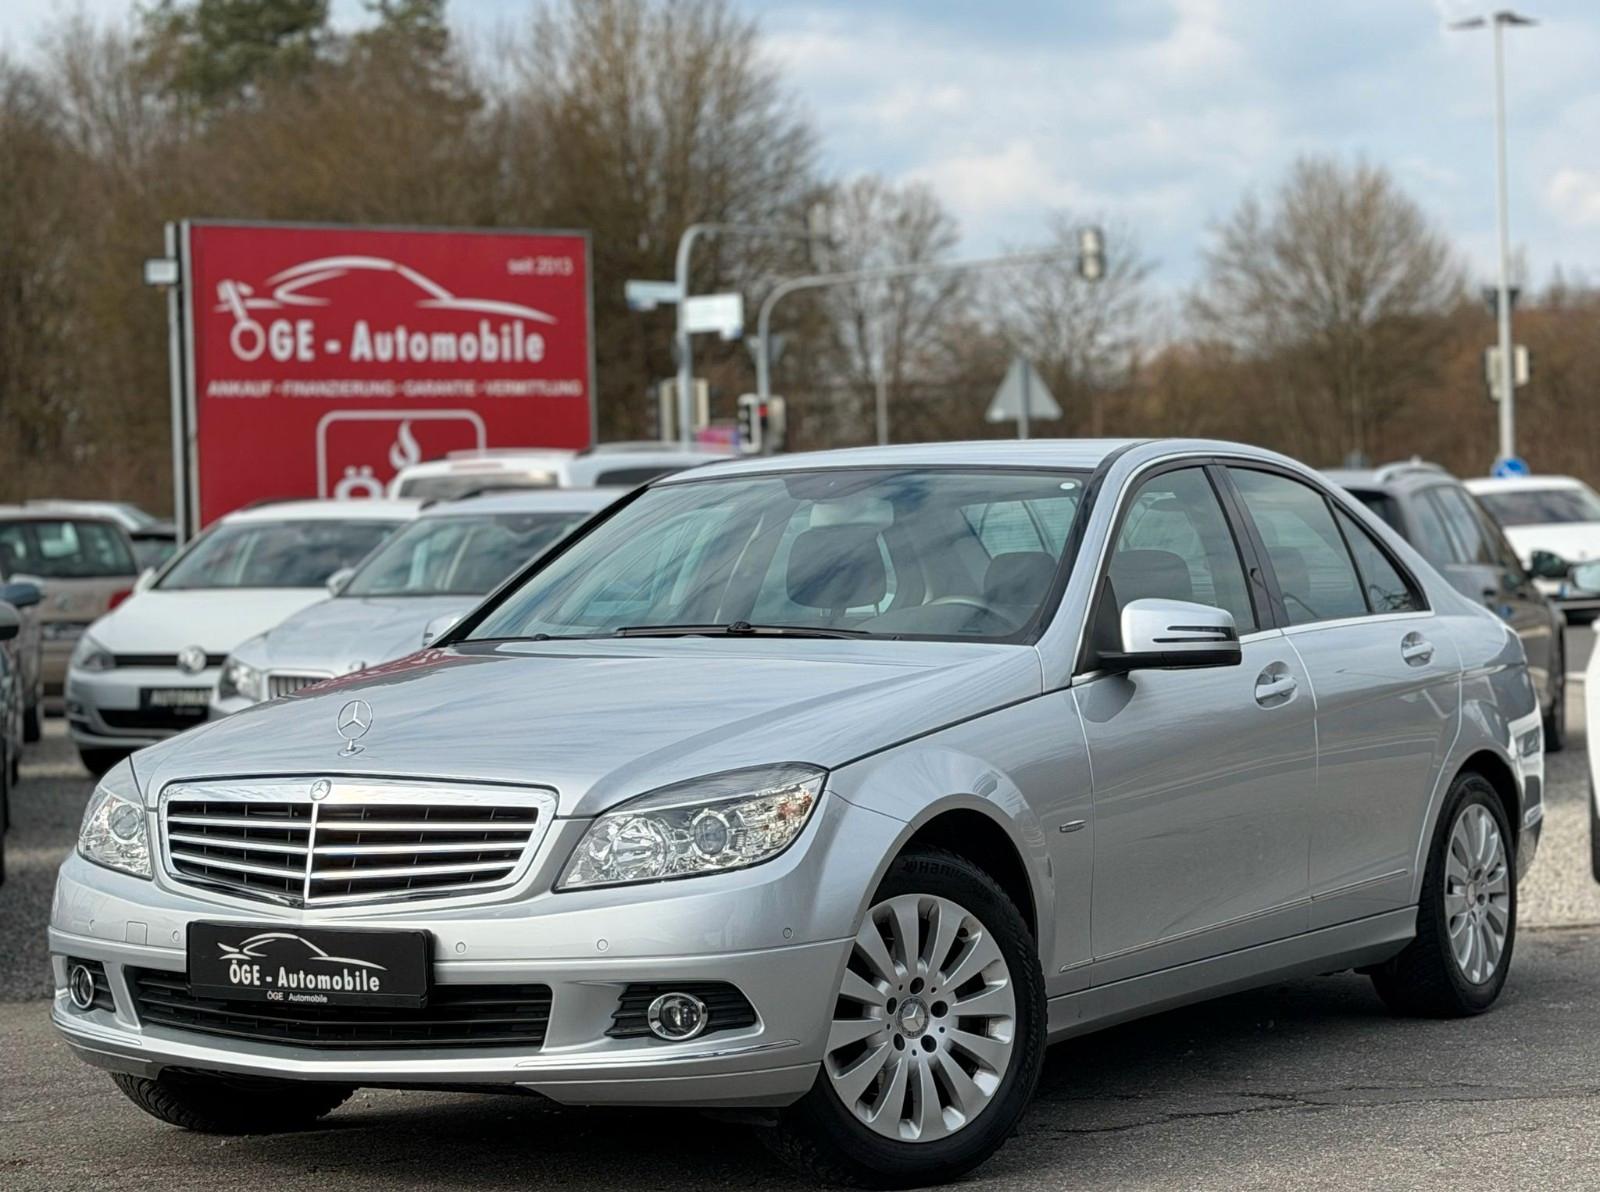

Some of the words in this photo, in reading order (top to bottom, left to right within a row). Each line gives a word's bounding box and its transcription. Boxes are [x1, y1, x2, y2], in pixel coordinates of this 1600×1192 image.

[349, 318, 546, 362] Automobile
[206, 379, 273, 398] ANKAUF
[281, 379, 395, 398] FINANZIERUNG
[403, 379, 476, 398] GARANTIE
[484, 379, 583, 398] VERMITTLUNG
[229, 959, 261, 986] ÖGE
[277, 966, 380, 991] Automobile
[266, 990, 284, 1001] ÖGE
[288, 992, 328, 1003] Automobile
